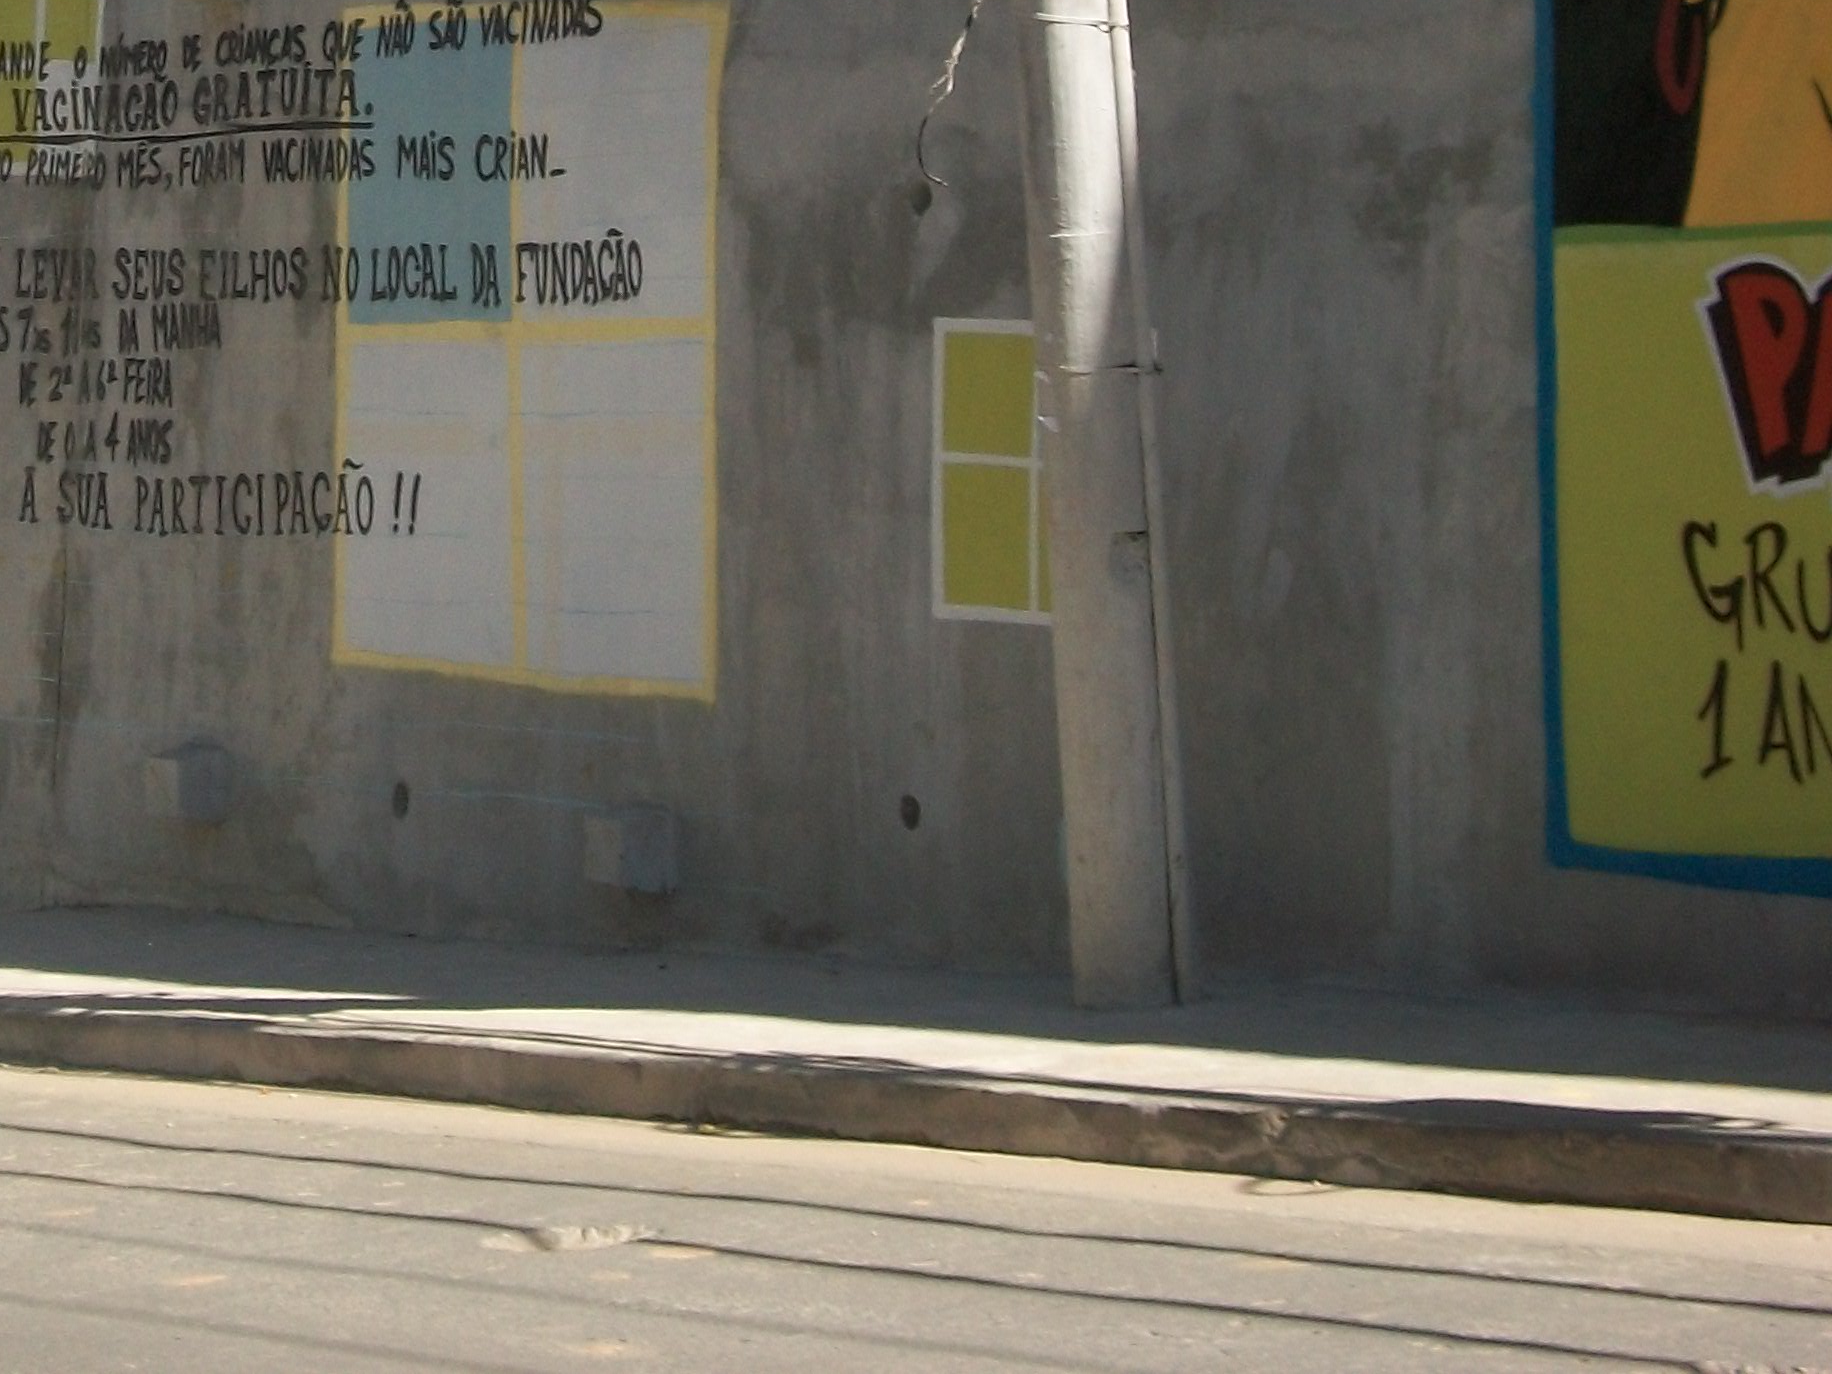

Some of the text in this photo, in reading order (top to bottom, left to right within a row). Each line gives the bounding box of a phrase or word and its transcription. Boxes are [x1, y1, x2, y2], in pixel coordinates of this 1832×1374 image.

[182, 33, 202, 73] DE
[323, 17, 366, 67] QUE
[178, 137, 245, 187] FORAM
[262, 133, 376, 183] VACINADAS
[395, 129, 456, 182] MAIS
[15, 246, 100, 303] LEVAR
[112, 246, 187, 301] SEUS
[321, 243, 360, 302] NO
[370, 242, 457, 302] LOCAL
[471, 242, 502, 308] DA
[18, 361, 39, 407] DE
[123, 357, 174, 409] FEIRA
[1701, 261, 1832, 486] P
[36, 421, 59, 464] DE
[104, 411, 120, 462] 4
[17, 464, 40, 524] A
[55, 467, 113, 530] SUA
[1697, 659, 1733, 780] 1
